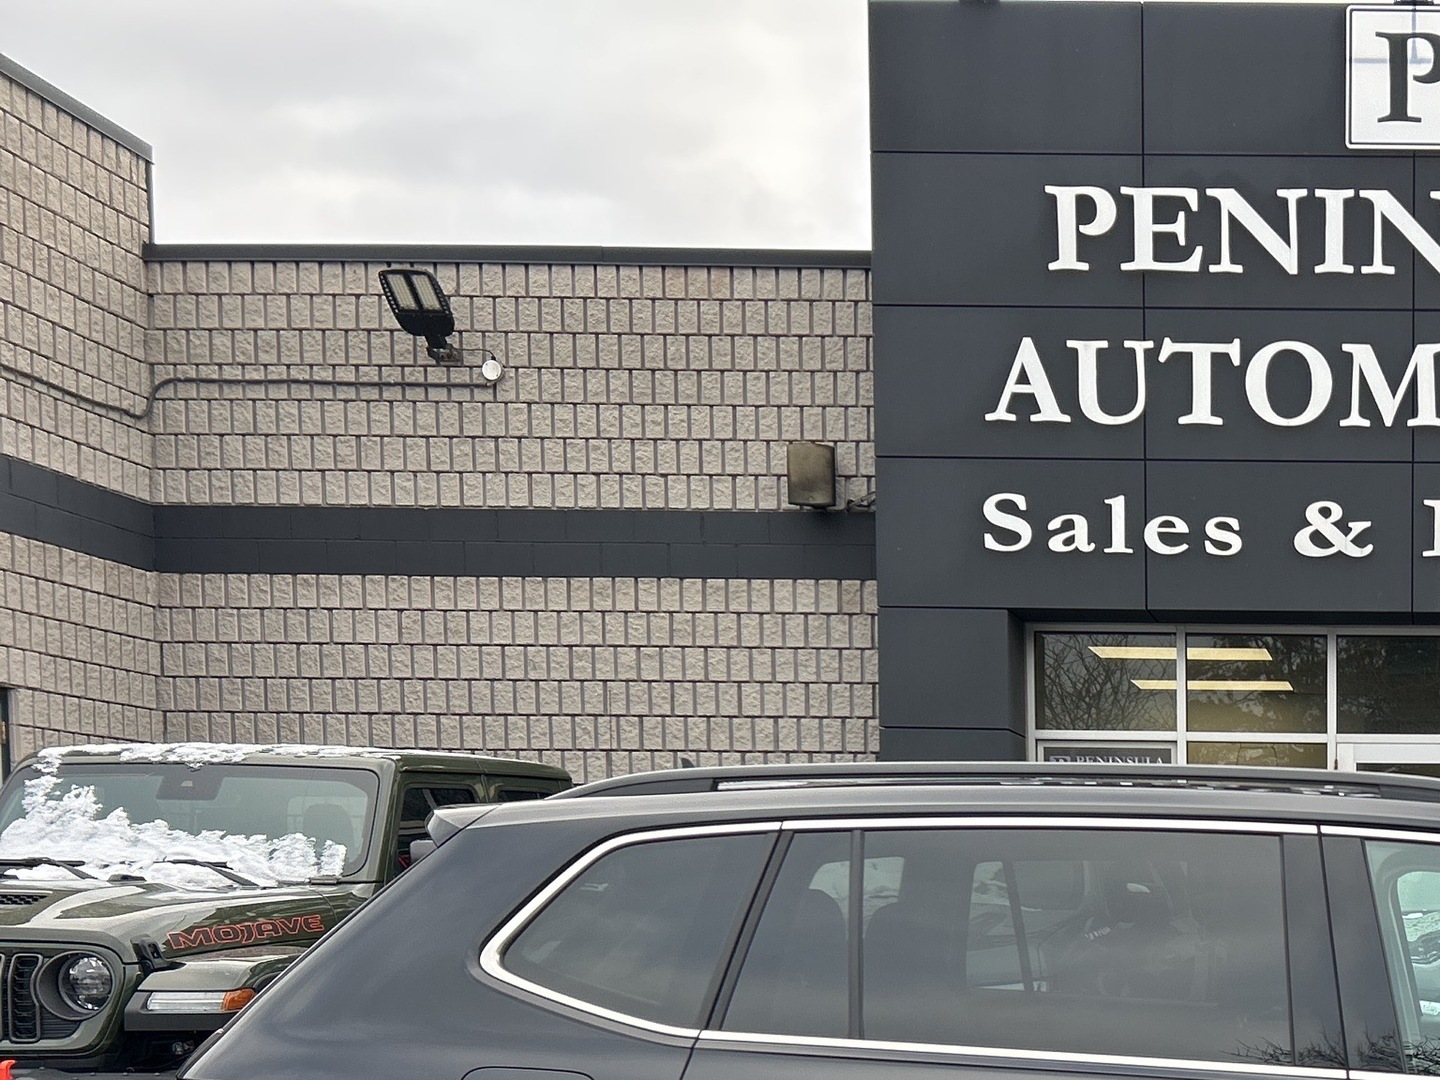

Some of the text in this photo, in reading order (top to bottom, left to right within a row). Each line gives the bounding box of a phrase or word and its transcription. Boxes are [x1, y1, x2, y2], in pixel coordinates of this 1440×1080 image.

[982, 492, 1243, 556] Sales
[1293, 500, 1374, 558] &
[166, 914, 325, 950] MOJAVE
